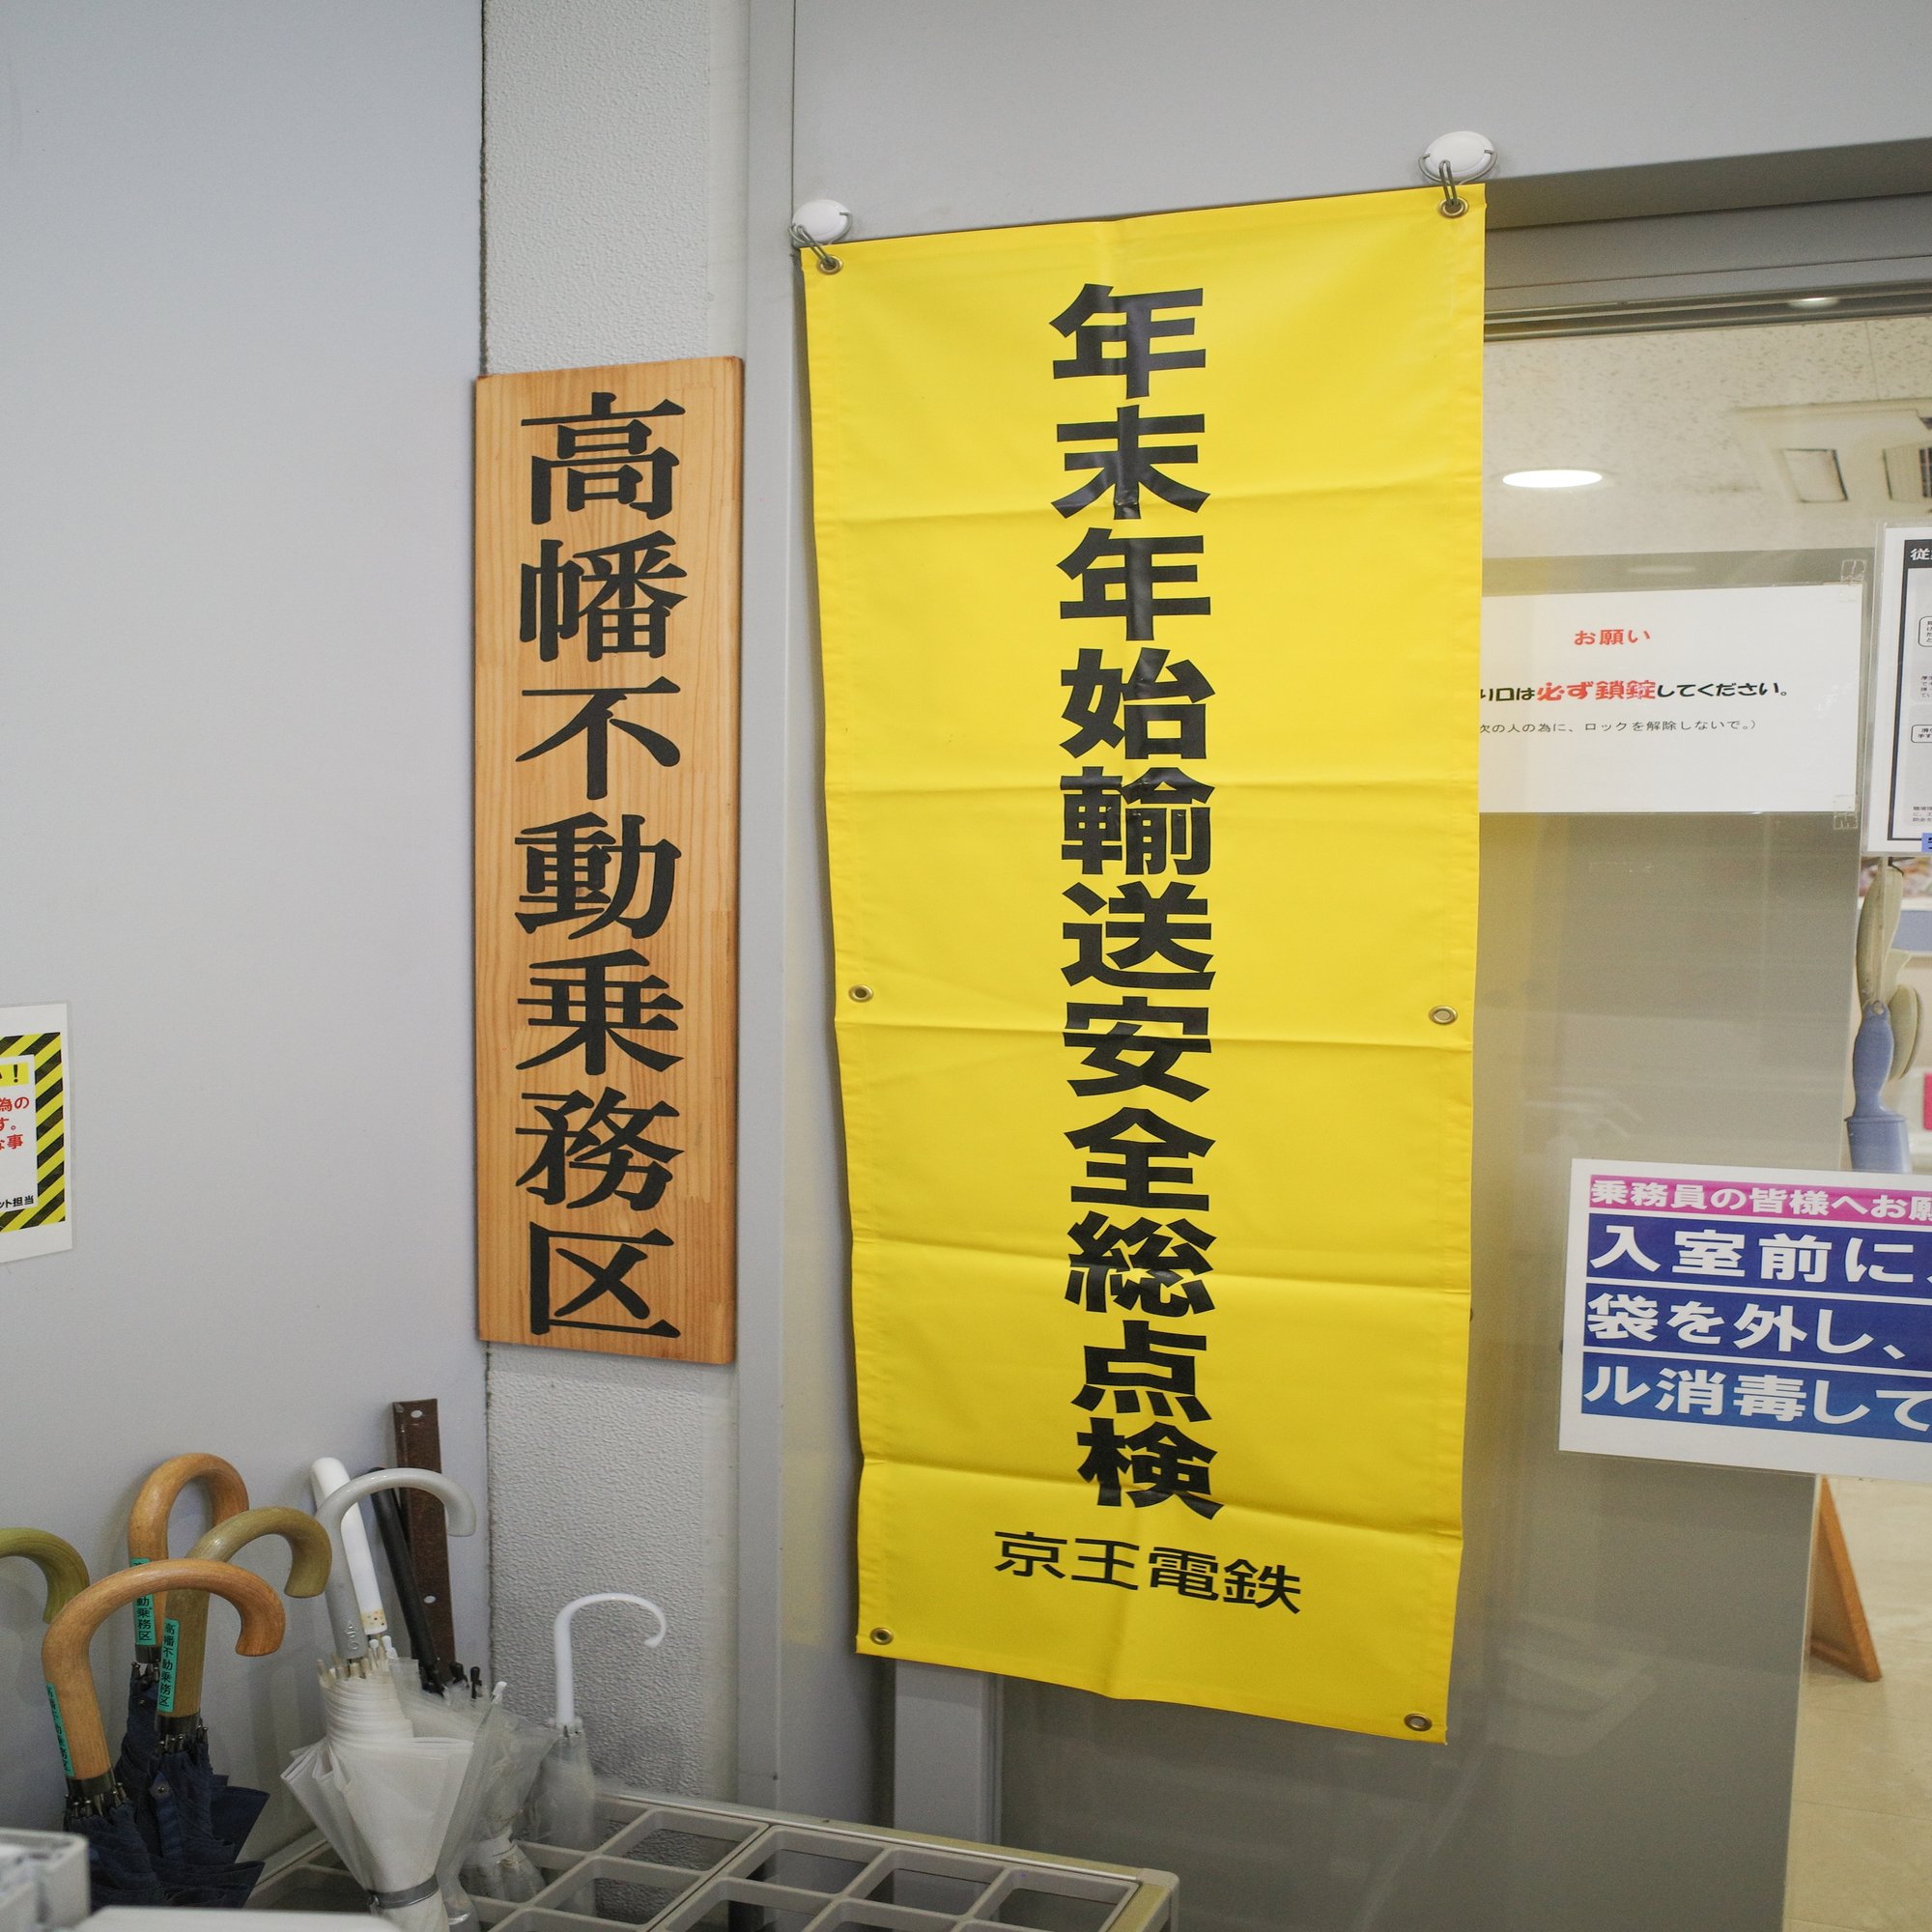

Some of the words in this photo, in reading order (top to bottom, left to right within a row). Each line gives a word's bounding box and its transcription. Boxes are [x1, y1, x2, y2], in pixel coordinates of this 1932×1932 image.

[1910, 548, 1932, 561] 従
[1574, 629, 1651, 645] お願い
[515, 391, 688, 1338] 高幡不動乗務区
[1049, 283, 1224, 1520] 年末年始輸送安全総点検
[1589, 1225, 1932, 1284] 入室前に
[1587, 1293, 1906, 1360] 袋を外し、
[1583, 1365, 1932, 1433] ル消毒して
[994, 1531, 1301, 1615] 京王電鉄
